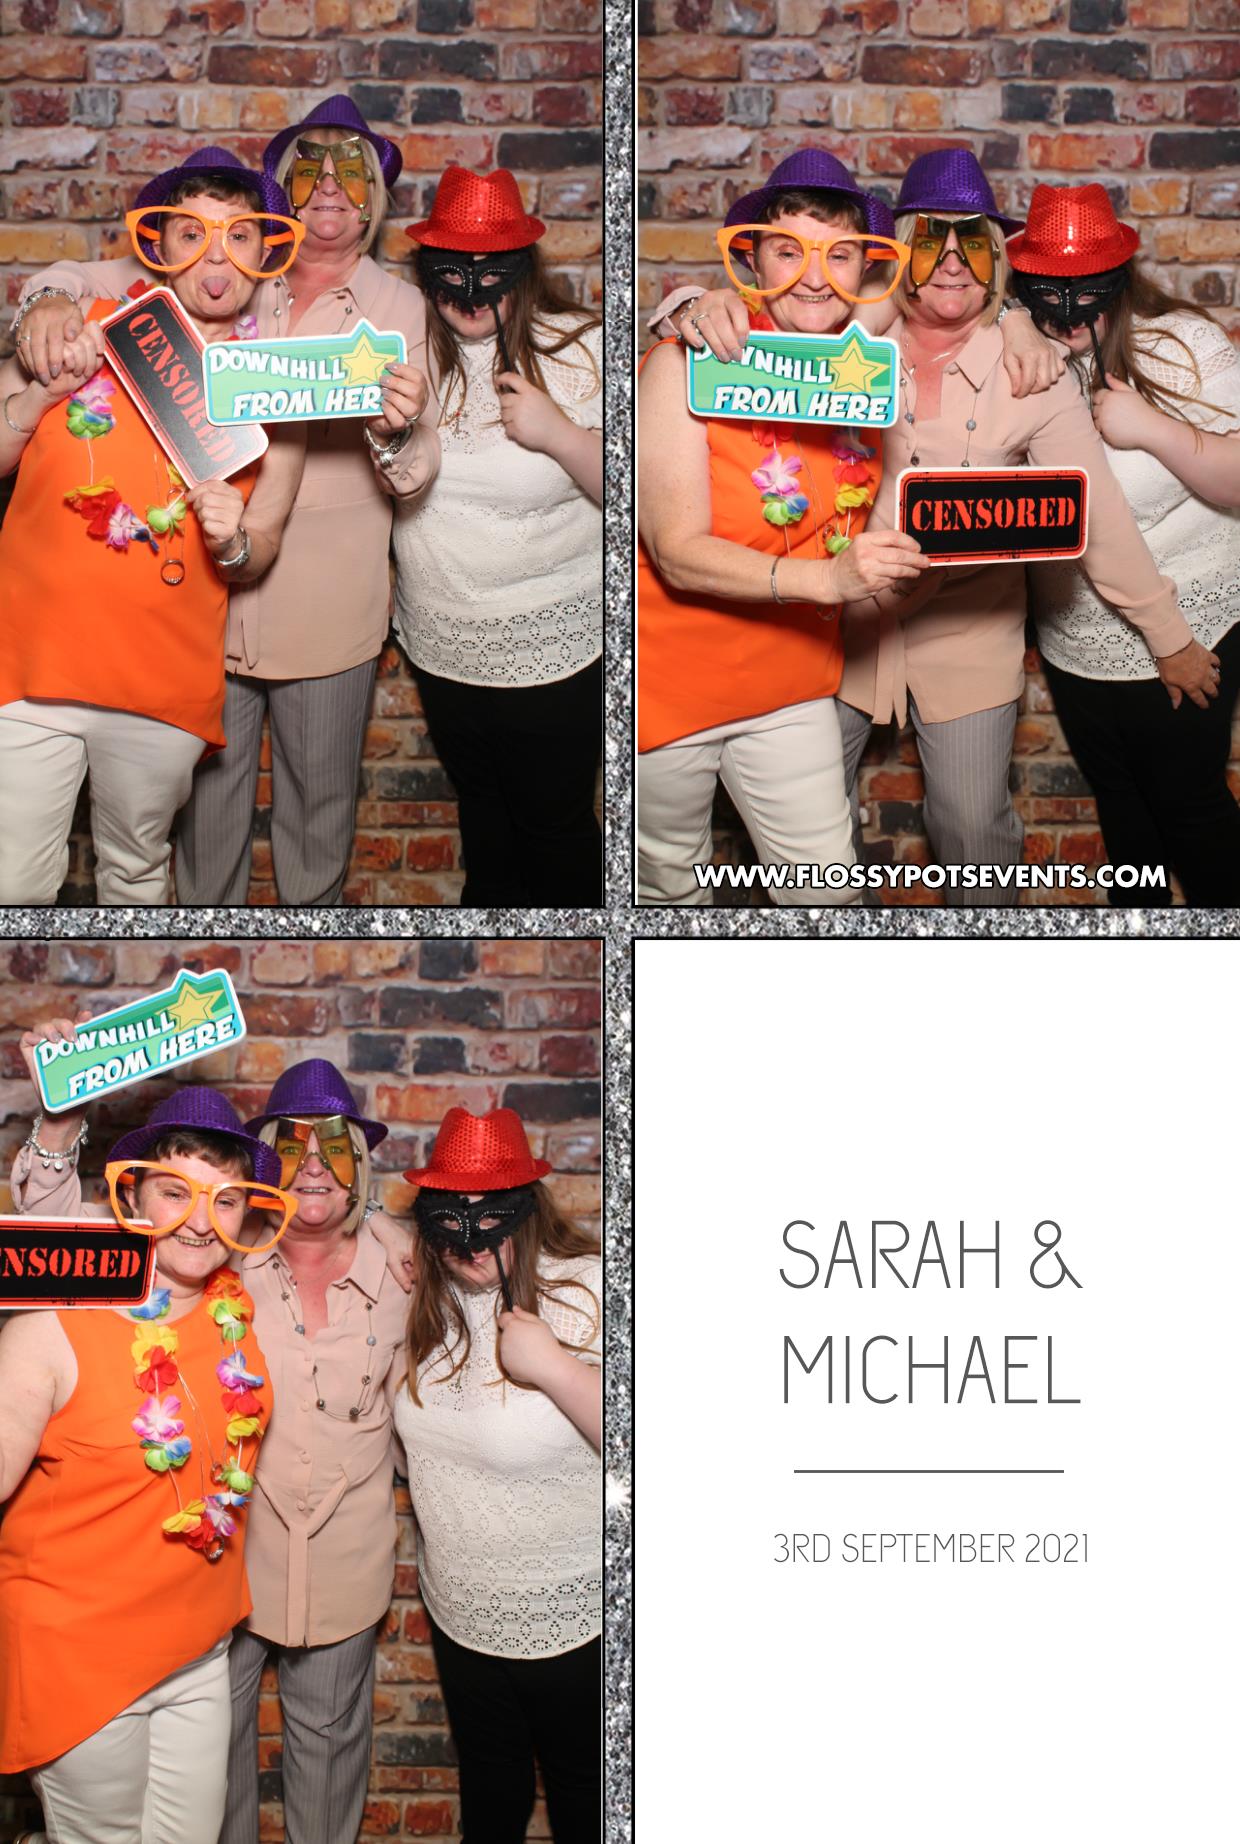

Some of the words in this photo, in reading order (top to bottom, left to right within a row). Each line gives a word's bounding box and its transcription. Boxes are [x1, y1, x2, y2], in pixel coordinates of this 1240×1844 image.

[209, 349, 346, 381] DOWNHILL
[128, 313, 236, 462] CENSORED
[233, 390, 315, 418] FROM
[325, 385, 382, 412] HER
[715, 385, 798, 416] FROM
[808, 394, 891, 422] HERE
[912, 497, 1076, 532] CENSORED
[39, 1011, 175, 1067] DOWNHILL
[68, 1048, 151, 1099] FROM
[160, 1015, 236, 1063] HERE
[0, 1247, 141, 1278] NSORED
